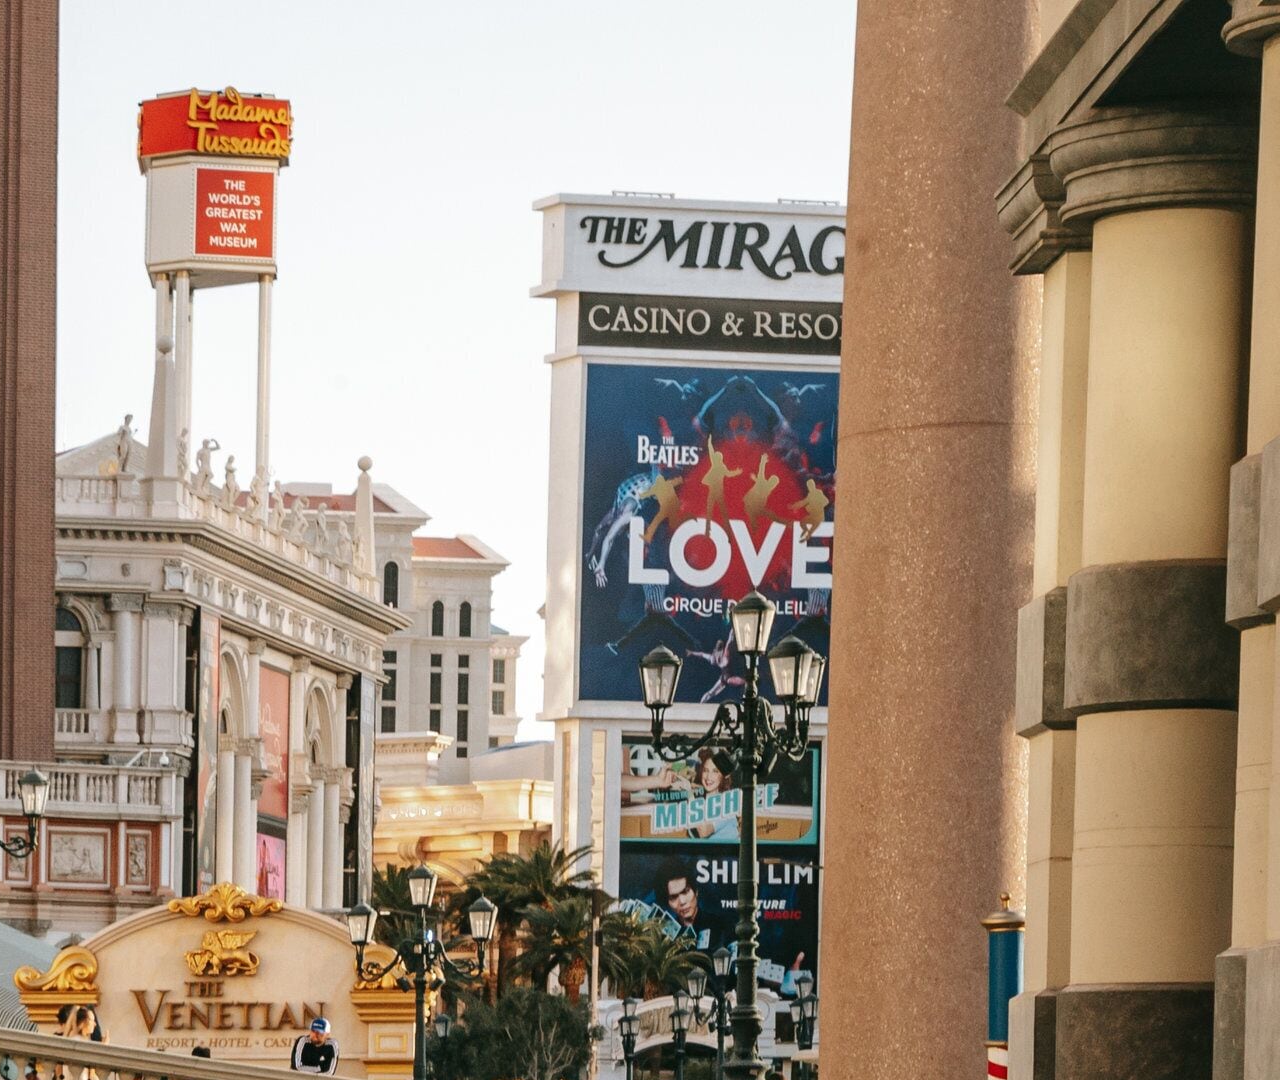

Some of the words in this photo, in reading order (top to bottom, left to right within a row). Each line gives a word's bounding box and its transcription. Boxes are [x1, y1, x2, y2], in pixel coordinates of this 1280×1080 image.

[188, 86, 290, 125] Madame
[187, 120, 292, 157] Tussauds
[224, 179, 246, 191] THE
[208, 193, 261, 206] WORLD'S
[205, 207, 263, 220] GREATEST
[220, 222, 247, 233] WAX
[579, 215, 648, 245] THE
[209, 236, 258, 248] MUSEUM
[597, 219, 847, 281] MIRAG
[588, 304, 712, 336] CASINO
[721, 311, 744, 337] &
[753, 311, 841, 341] RESO
[662, 436, 675, 445] THE
[628, 515, 834, 589] LOVE
[663, 597, 723, 618] CIRQUE
[655, 783, 779, 830] MISCHEF
[768, 860, 813, 885] LIM
[763, 911, 801, 920] MAGIC
[184, 981, 224, 998] THE
[130, 989, 326, 1034] VENETIAN
[146, 1037, 198, 1049] RESORT
[208, 1037, 252, 1049] HOTEL
[263, 1037, 295, 1049] CASI
